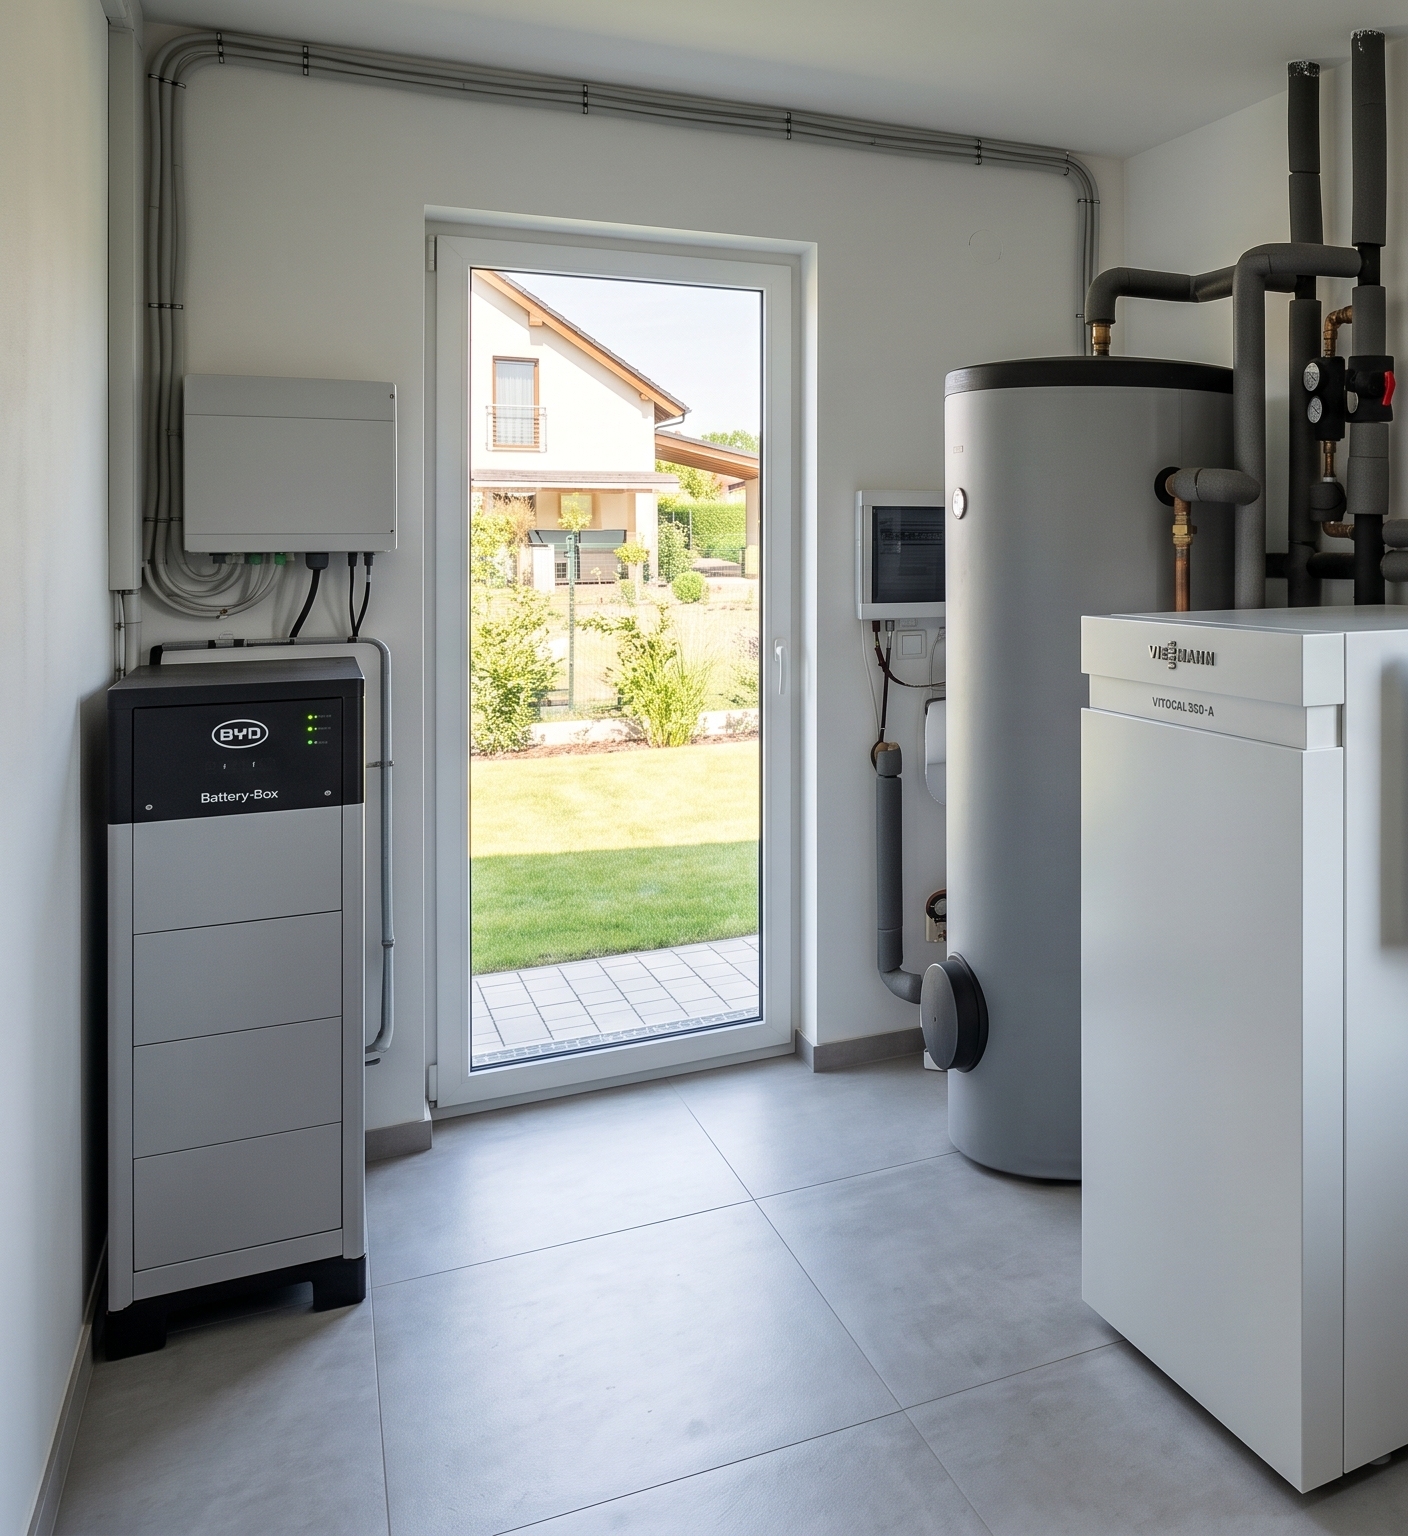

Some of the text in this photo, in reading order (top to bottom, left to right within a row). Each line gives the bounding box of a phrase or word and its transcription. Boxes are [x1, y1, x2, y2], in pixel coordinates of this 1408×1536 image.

[1152, 697, 1187, 712] VITOCAL
[220, 727, 261, 742] BYD
[201, 790, 278, 803] Battery-Box
